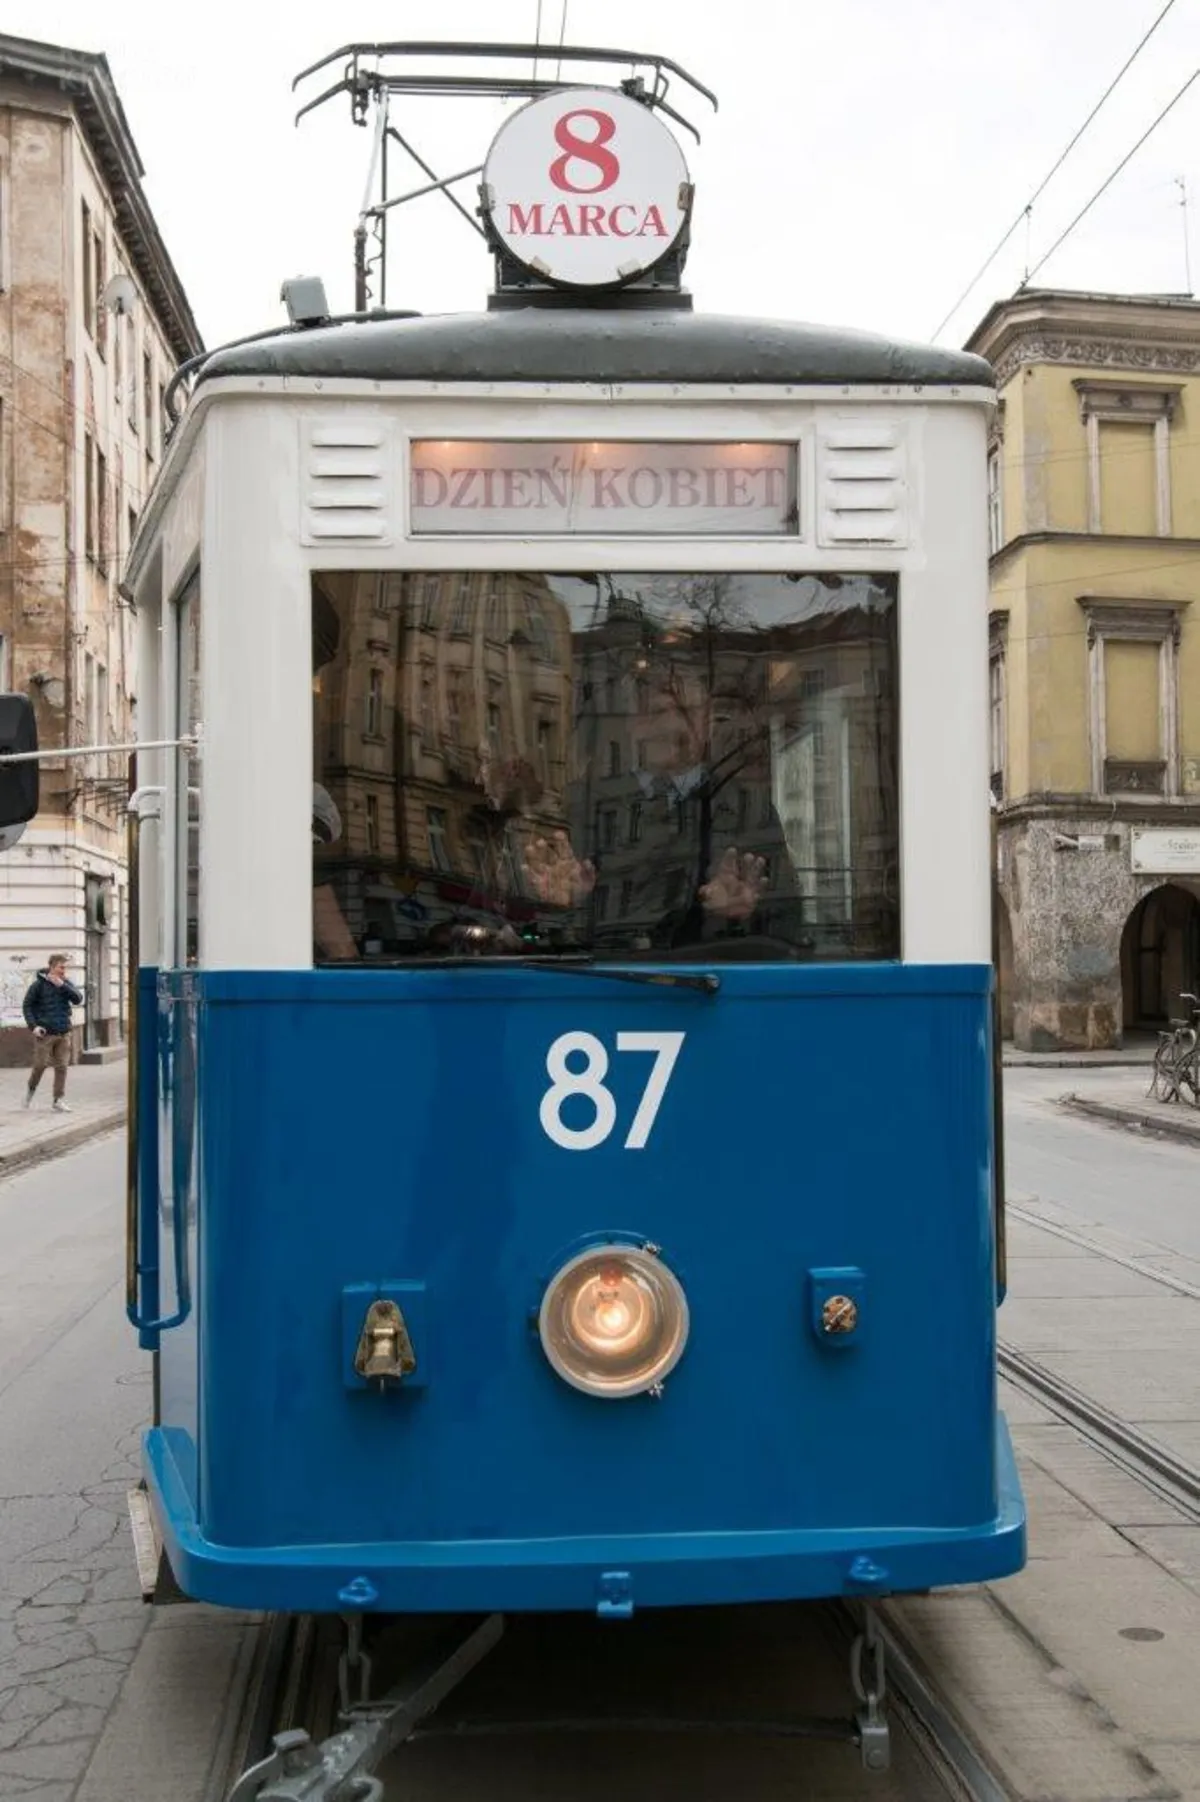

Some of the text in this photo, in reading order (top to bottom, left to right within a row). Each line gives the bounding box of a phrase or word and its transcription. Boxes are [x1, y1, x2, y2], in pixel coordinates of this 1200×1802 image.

[548, 108, 620, 194] 8
[507, 203, 669, 237] MARCA
[411, 456, 785, 508] DZIEŃ KOBIET
[539, 1031, 685, 1149] 87
